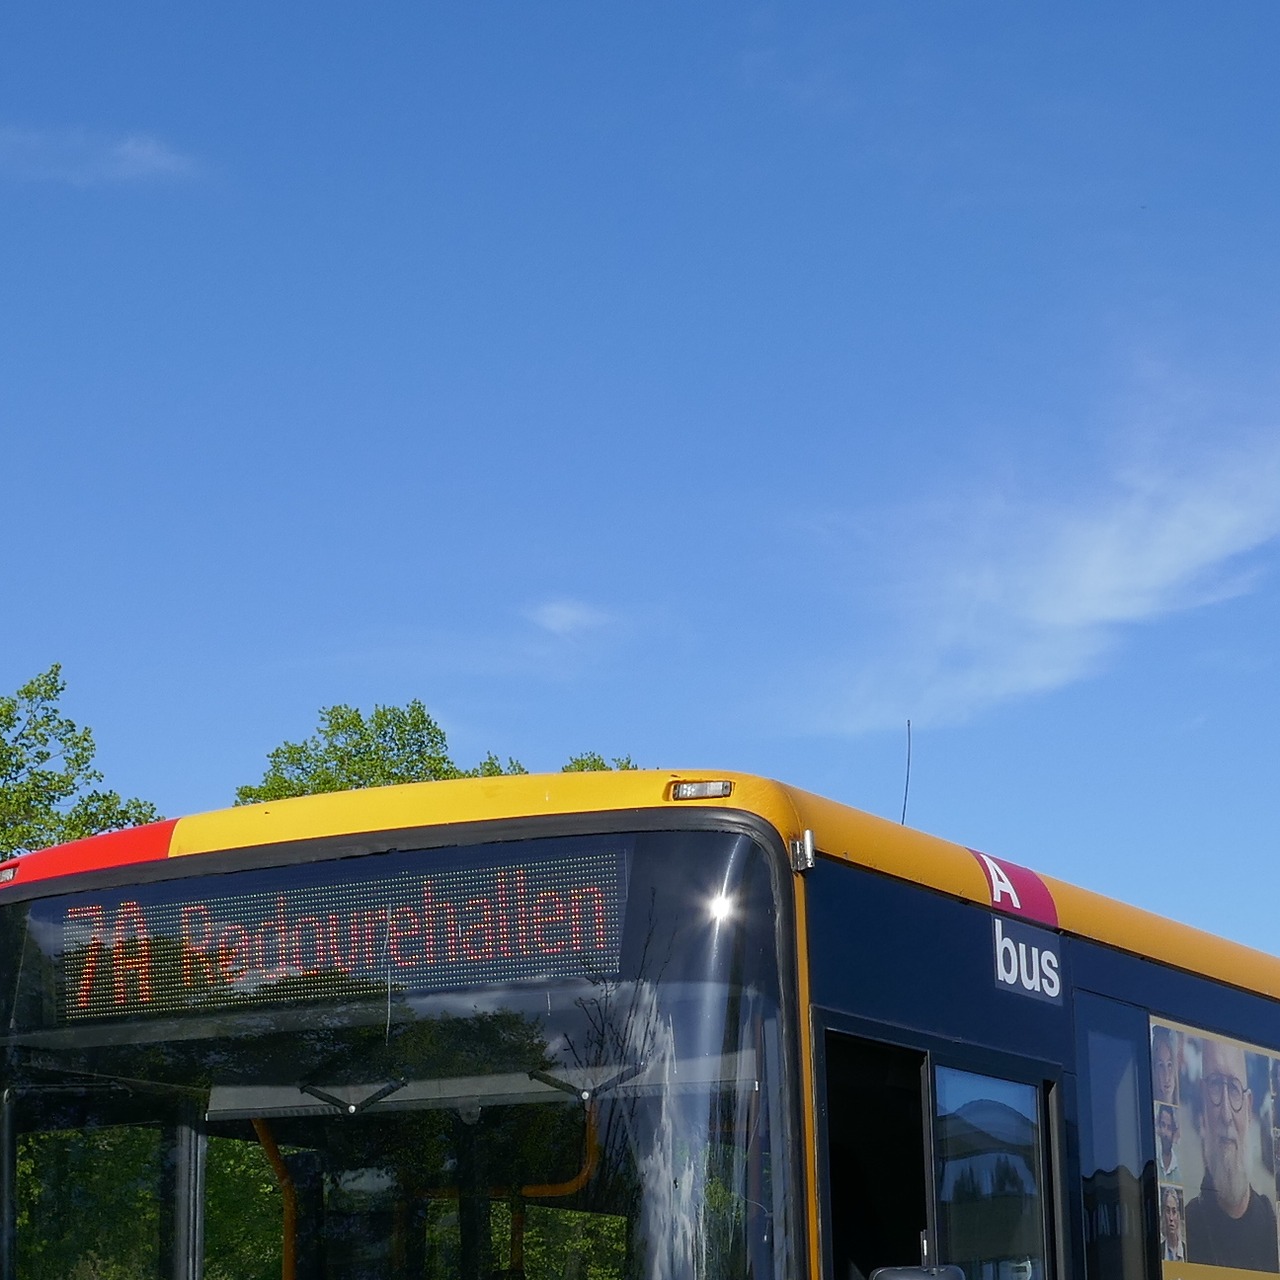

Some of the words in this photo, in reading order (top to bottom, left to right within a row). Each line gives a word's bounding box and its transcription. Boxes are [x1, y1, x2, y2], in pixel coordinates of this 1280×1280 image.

[979, 853, 1021, 909] A
[67, 900, 152, 1008] 7A
[994, 918, 1060, 998] bus
